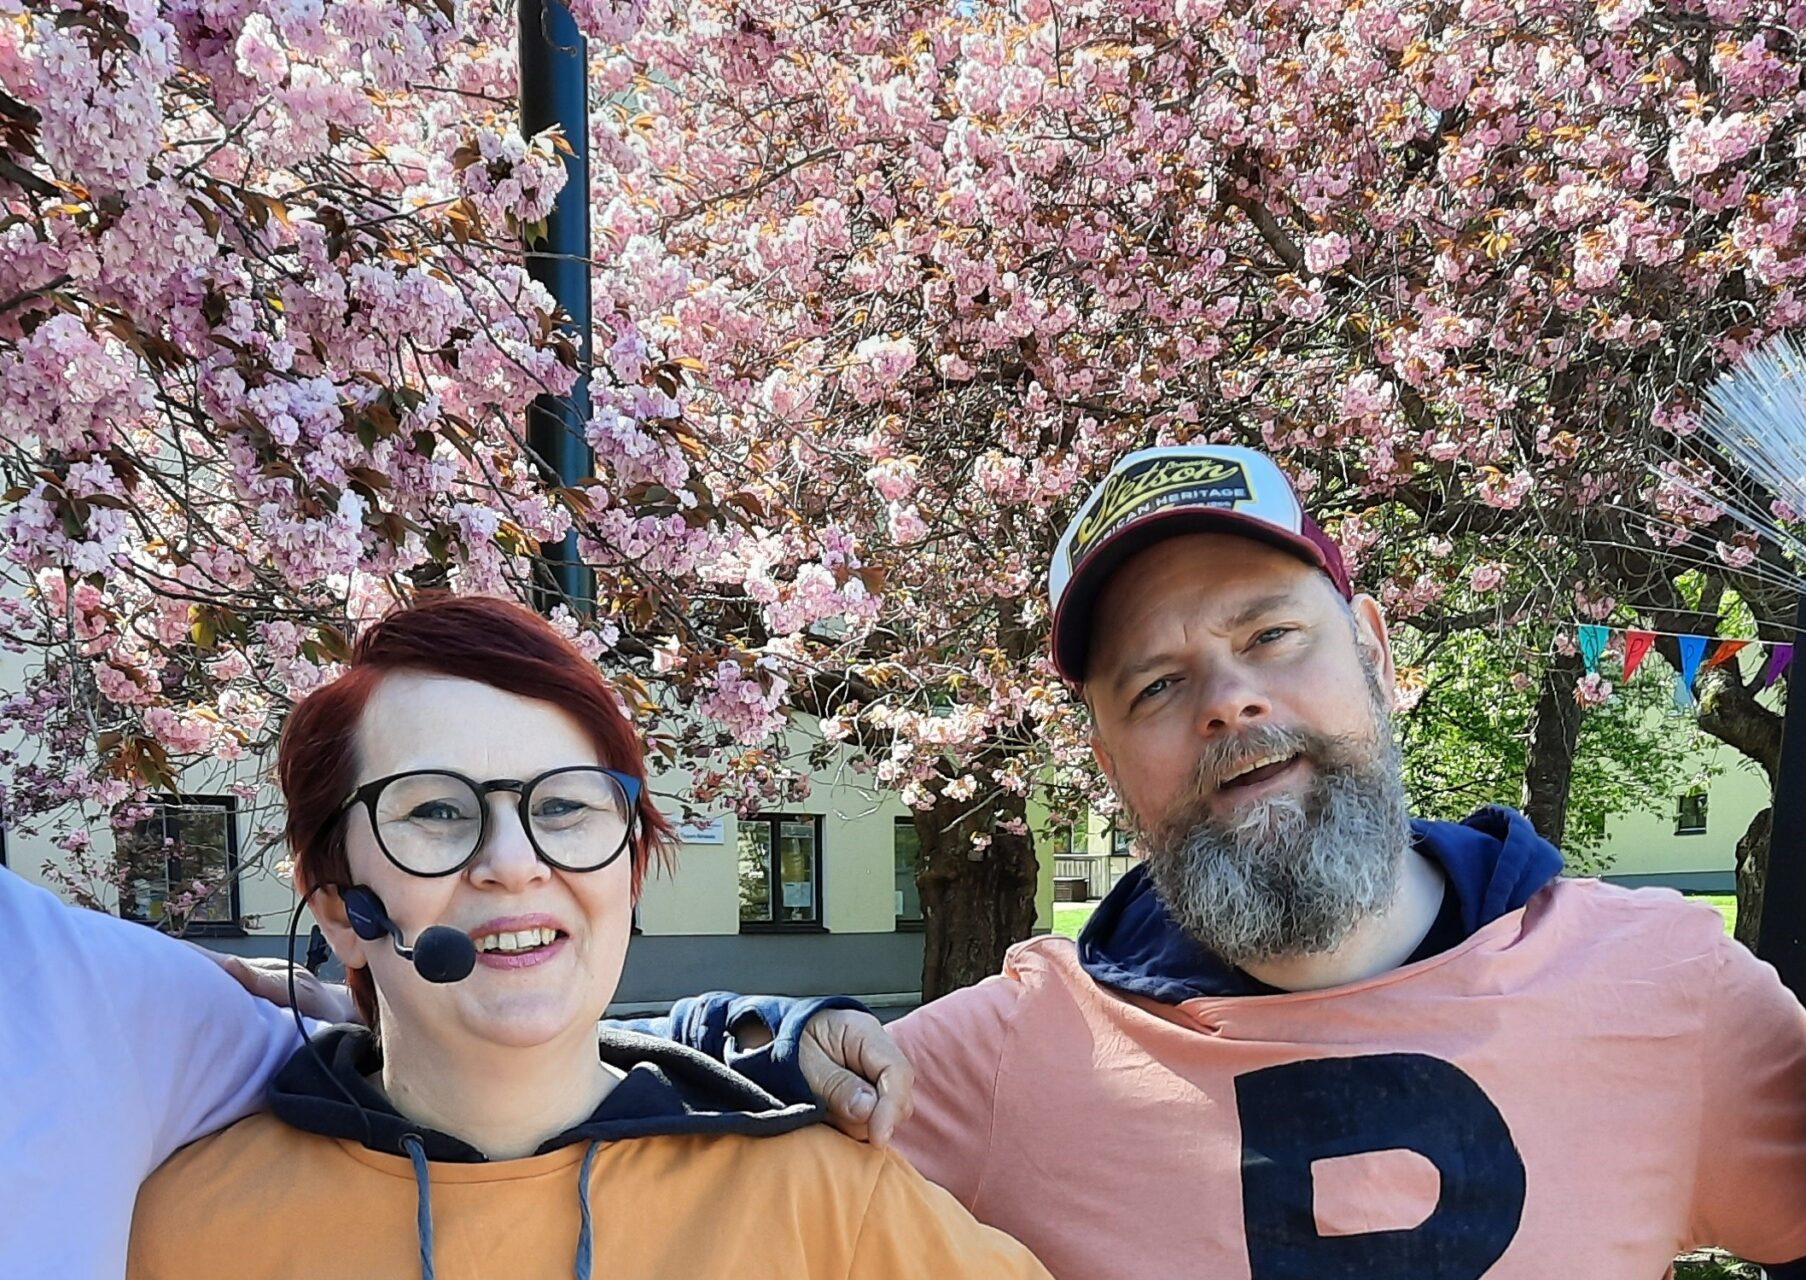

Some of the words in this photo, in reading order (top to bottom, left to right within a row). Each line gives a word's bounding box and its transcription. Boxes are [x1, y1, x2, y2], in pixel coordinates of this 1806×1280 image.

[1077, 460, 1239, 546] Stetson
[1096, 503, 1151, 545] RICAN
[1155, 488, 1246, 506] HERITAGE
